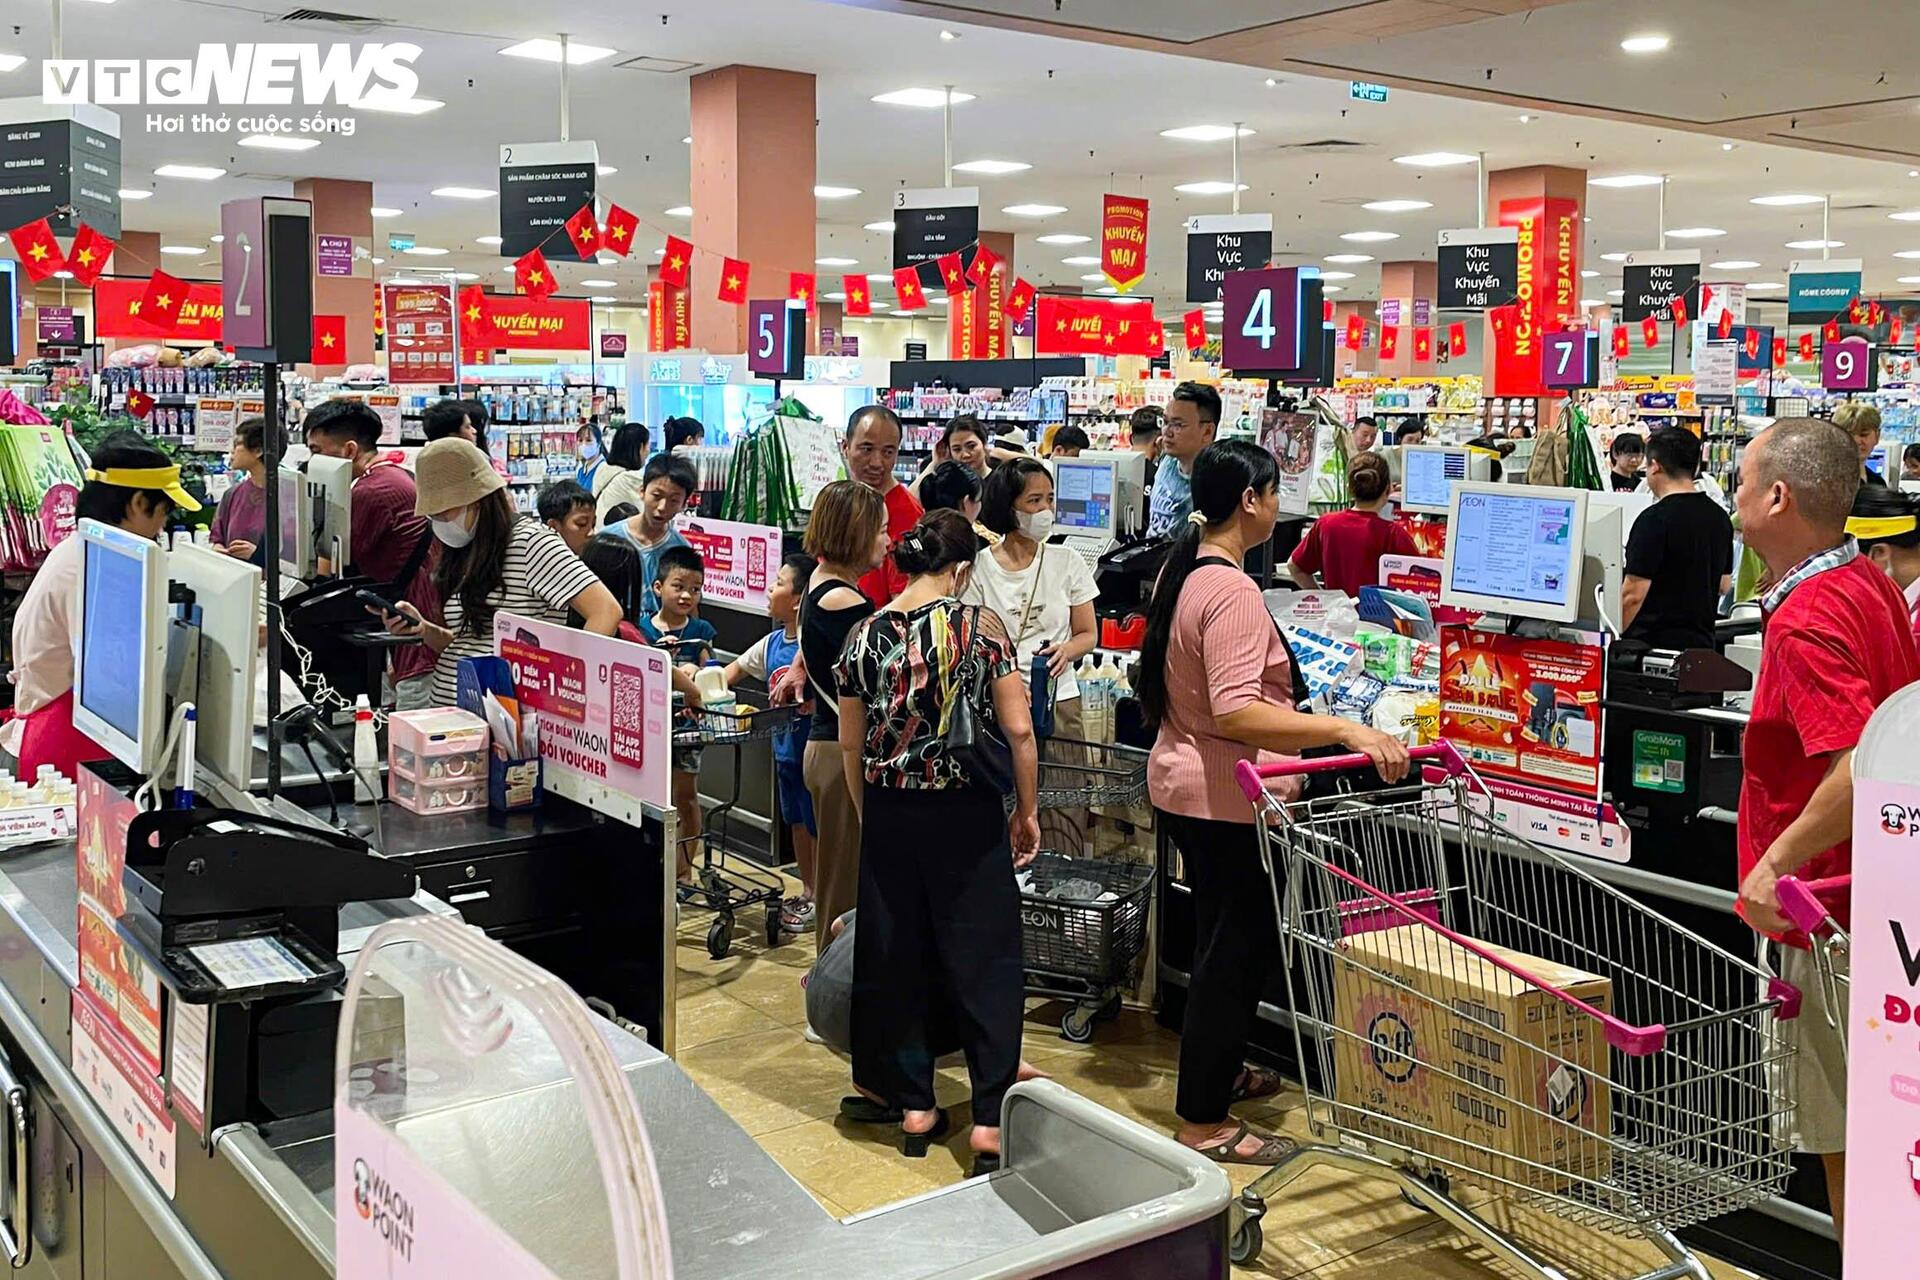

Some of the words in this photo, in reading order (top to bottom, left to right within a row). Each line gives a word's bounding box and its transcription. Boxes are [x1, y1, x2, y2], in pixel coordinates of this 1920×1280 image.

[504, 147, 512, 163] 2
[898, 192, 905, 207] 3
[1106, 206, 1145, 219] PROMOTION
[1191, 219, 1199, 231] 4
[1105, 225, 1145, 245] KHUYẾN
[1217, 235, 1241, 248] Khu
[1441, 232, 1449, 244] 5
[1110, 248, 1137, 268] MẠI
[1217, 250, 1242, 266] Vực
[1466, 247, 1489, 258] Khu
[1626, 253, 1634, 264] 6
[1466, 261, 1490, 273] Vực
[1650, 267, 1673, 278] Khu
[1650, 280, 1673, 293] Vực
[493, 312, 537, 329] HUYẾN
[539, 316, 563, 333] MẠI
[1242, 288, 1276, 349] 4
[758, 313, 774, 359] 5
[1554, 341, 1573, 375] 7
[1836, 351, 1854, 380] 9
[725, 575, 746, 588] WAON
[703, 581, 715, 593] ĐỔI
[716, 587, 745, 600] VOUCHER
[523, 664, 539, 677] ĐIỂM
[521, 676, 541, 691] WAON
[548, 672, 555, 696] 1
[561, 676, 582, 690] WAON
[557, 687, 587, 705] VOUCHER
[540, 718, 554, 732] TÍCH
[555, 721, 573, 739] ĐIỂM
[573, 727, 608, 756] WAON
[614, 731, 625, 744] TẢI
[625, 735, 640, 748] APP
[1637, 732, 1682, 748] GrabMart
[540, 735, 558, 760] ĐỔI
[559, 747, 607, 779] VOUCHER
[1506, 787, 1525, 799] TOÁN
[1525, 791, 1551, 803] THÔNG
[1551, 797, 1569, 809] MINH
[1530, 821, 1548, 832] VISA
[371, 1168, 414, 1234] WAON
[373, 1202, 415, 1264] POINT
